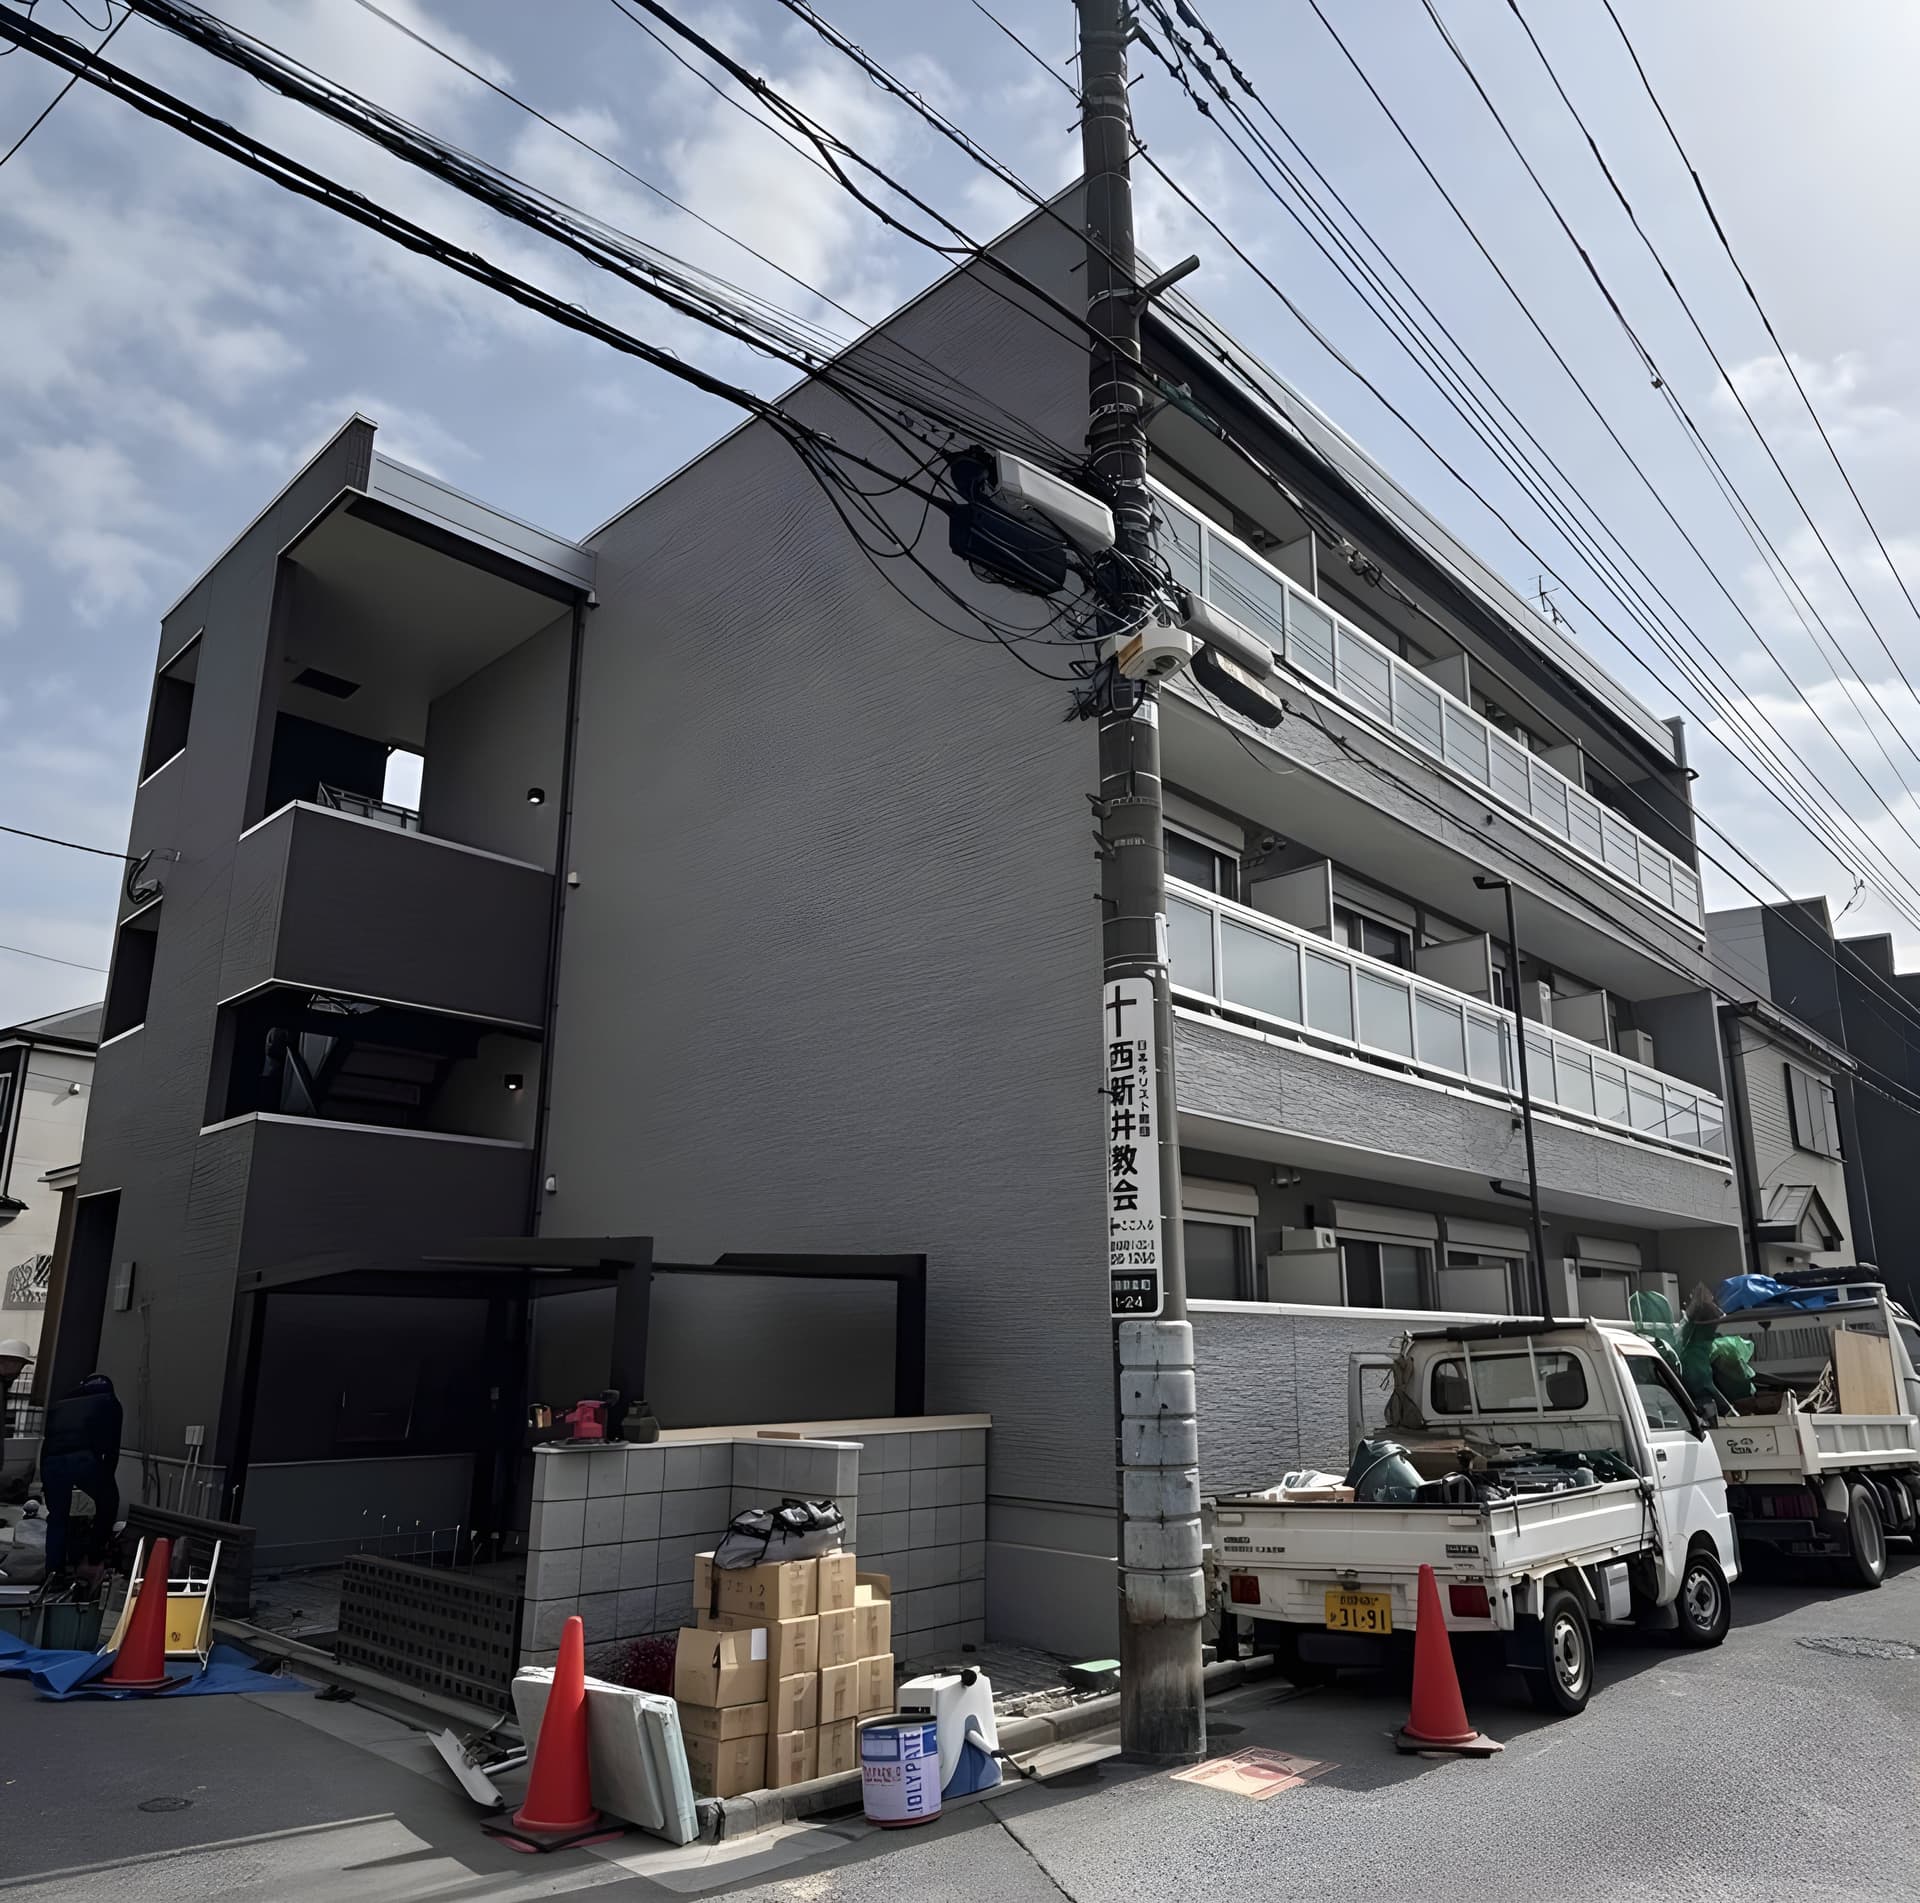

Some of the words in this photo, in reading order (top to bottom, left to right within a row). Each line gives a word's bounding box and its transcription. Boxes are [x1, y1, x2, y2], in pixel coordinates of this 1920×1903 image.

[1109, 1040, 1138, 1211] 西新井教会
[904, 1731, 923, 1813] JOLYPATE
